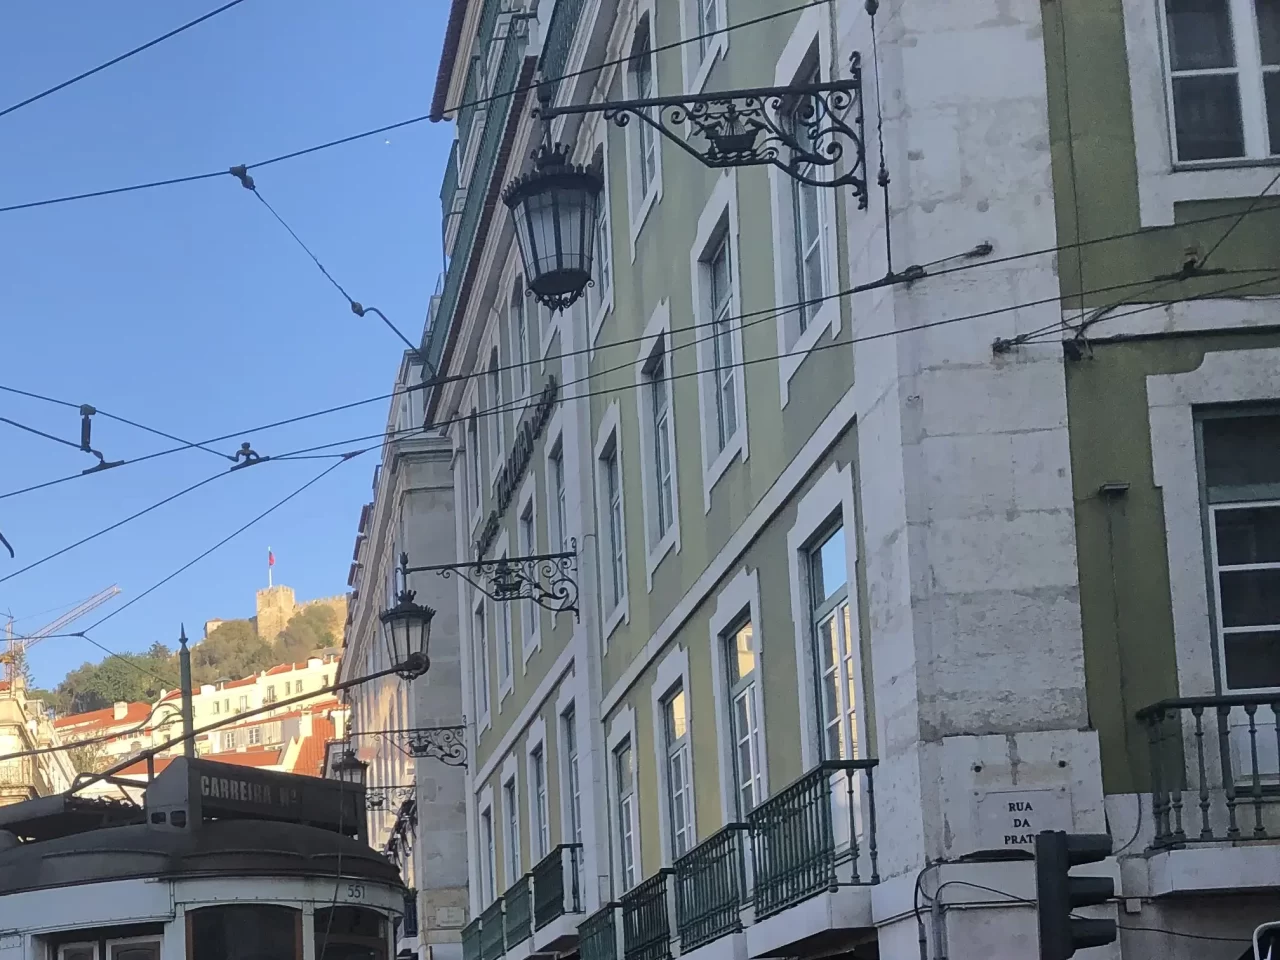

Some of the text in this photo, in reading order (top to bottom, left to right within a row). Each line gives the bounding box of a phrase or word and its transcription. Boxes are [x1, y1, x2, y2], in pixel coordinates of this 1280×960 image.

[200, 775, 271, 804] CARREIRA
[1008, 802, 1033, 812] RUA
[1013, 818, 1031, 828] DA
[1004, 834, 1035, 845] PRAT
[347, 885, 366, 899] 551
